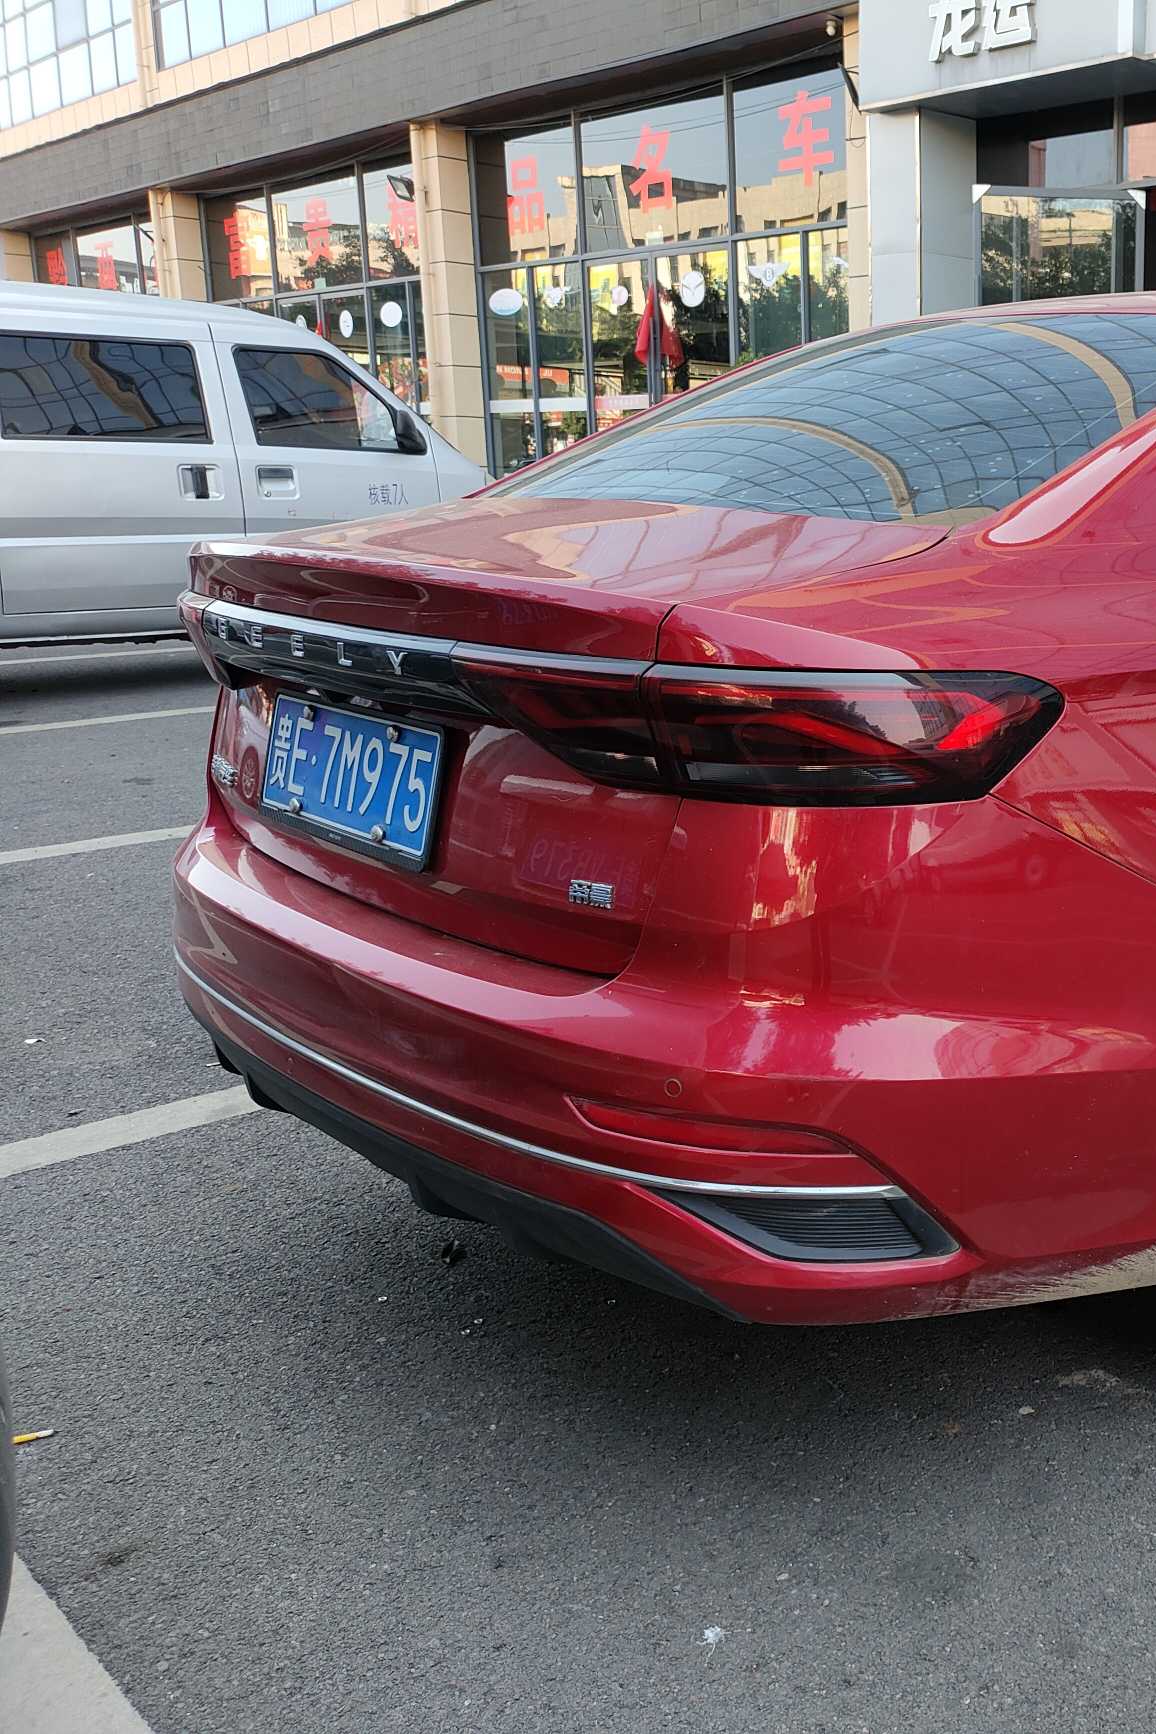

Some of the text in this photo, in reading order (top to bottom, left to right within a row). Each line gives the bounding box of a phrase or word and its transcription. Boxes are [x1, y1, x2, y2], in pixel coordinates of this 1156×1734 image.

[368, 483, 409, 505] 核载7人
[217, 616, 409, 676] GEELY
